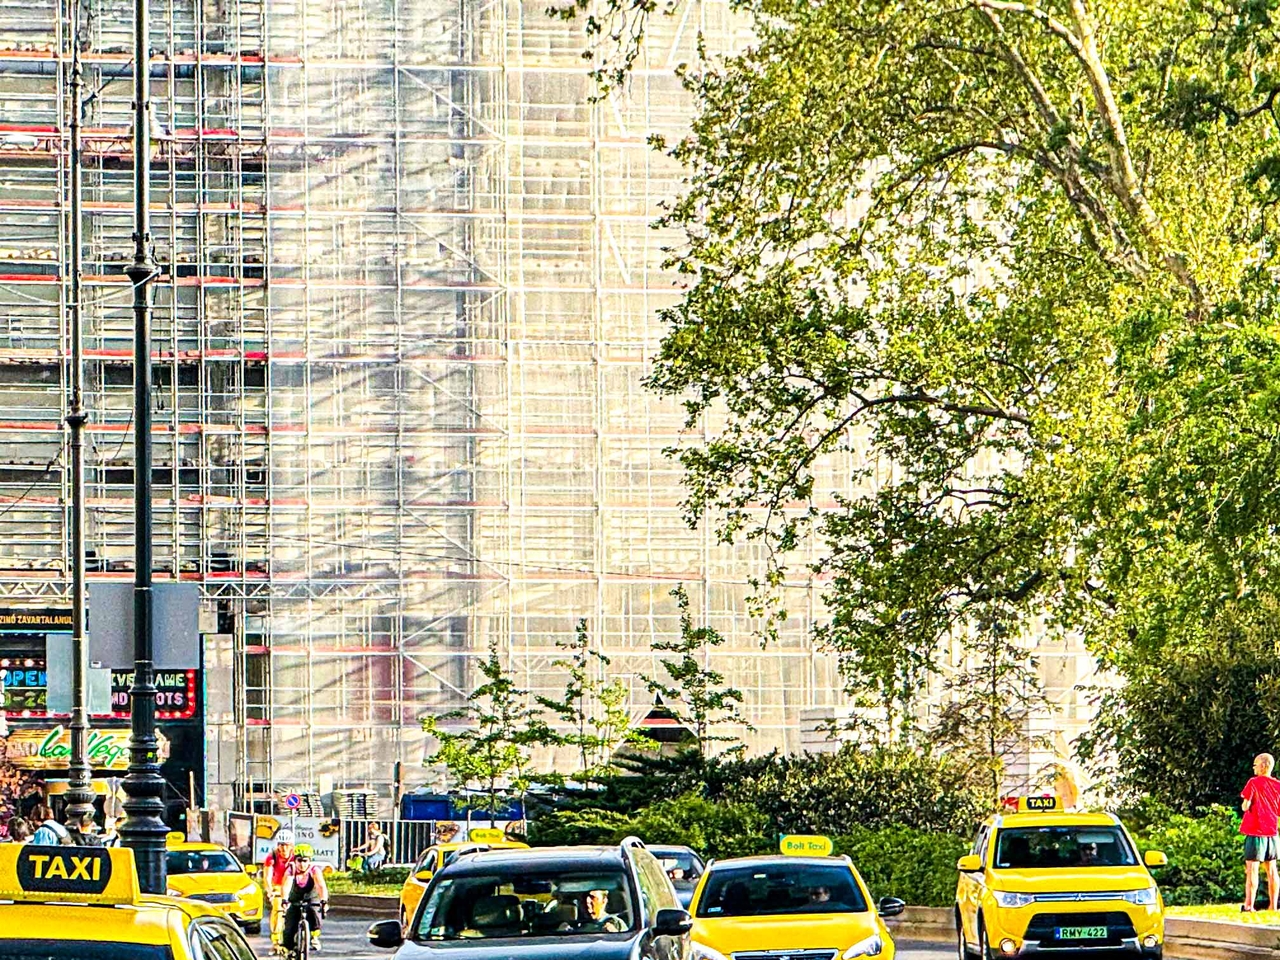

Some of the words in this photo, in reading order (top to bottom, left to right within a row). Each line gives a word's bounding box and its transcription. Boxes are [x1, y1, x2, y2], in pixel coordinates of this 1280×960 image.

[111, 673, 134, 687] IVE
[155, 673, 185, 687] AME
[39, 727, 71, 759] La
[88, 731, 130, 767] Vega
[1029, 798, 1053, 808] TAXI
[786, 841, 805, 850] Bolt
[807, 841, 826, 851] Taxi
[28, 855, 101, 881] TAXI
